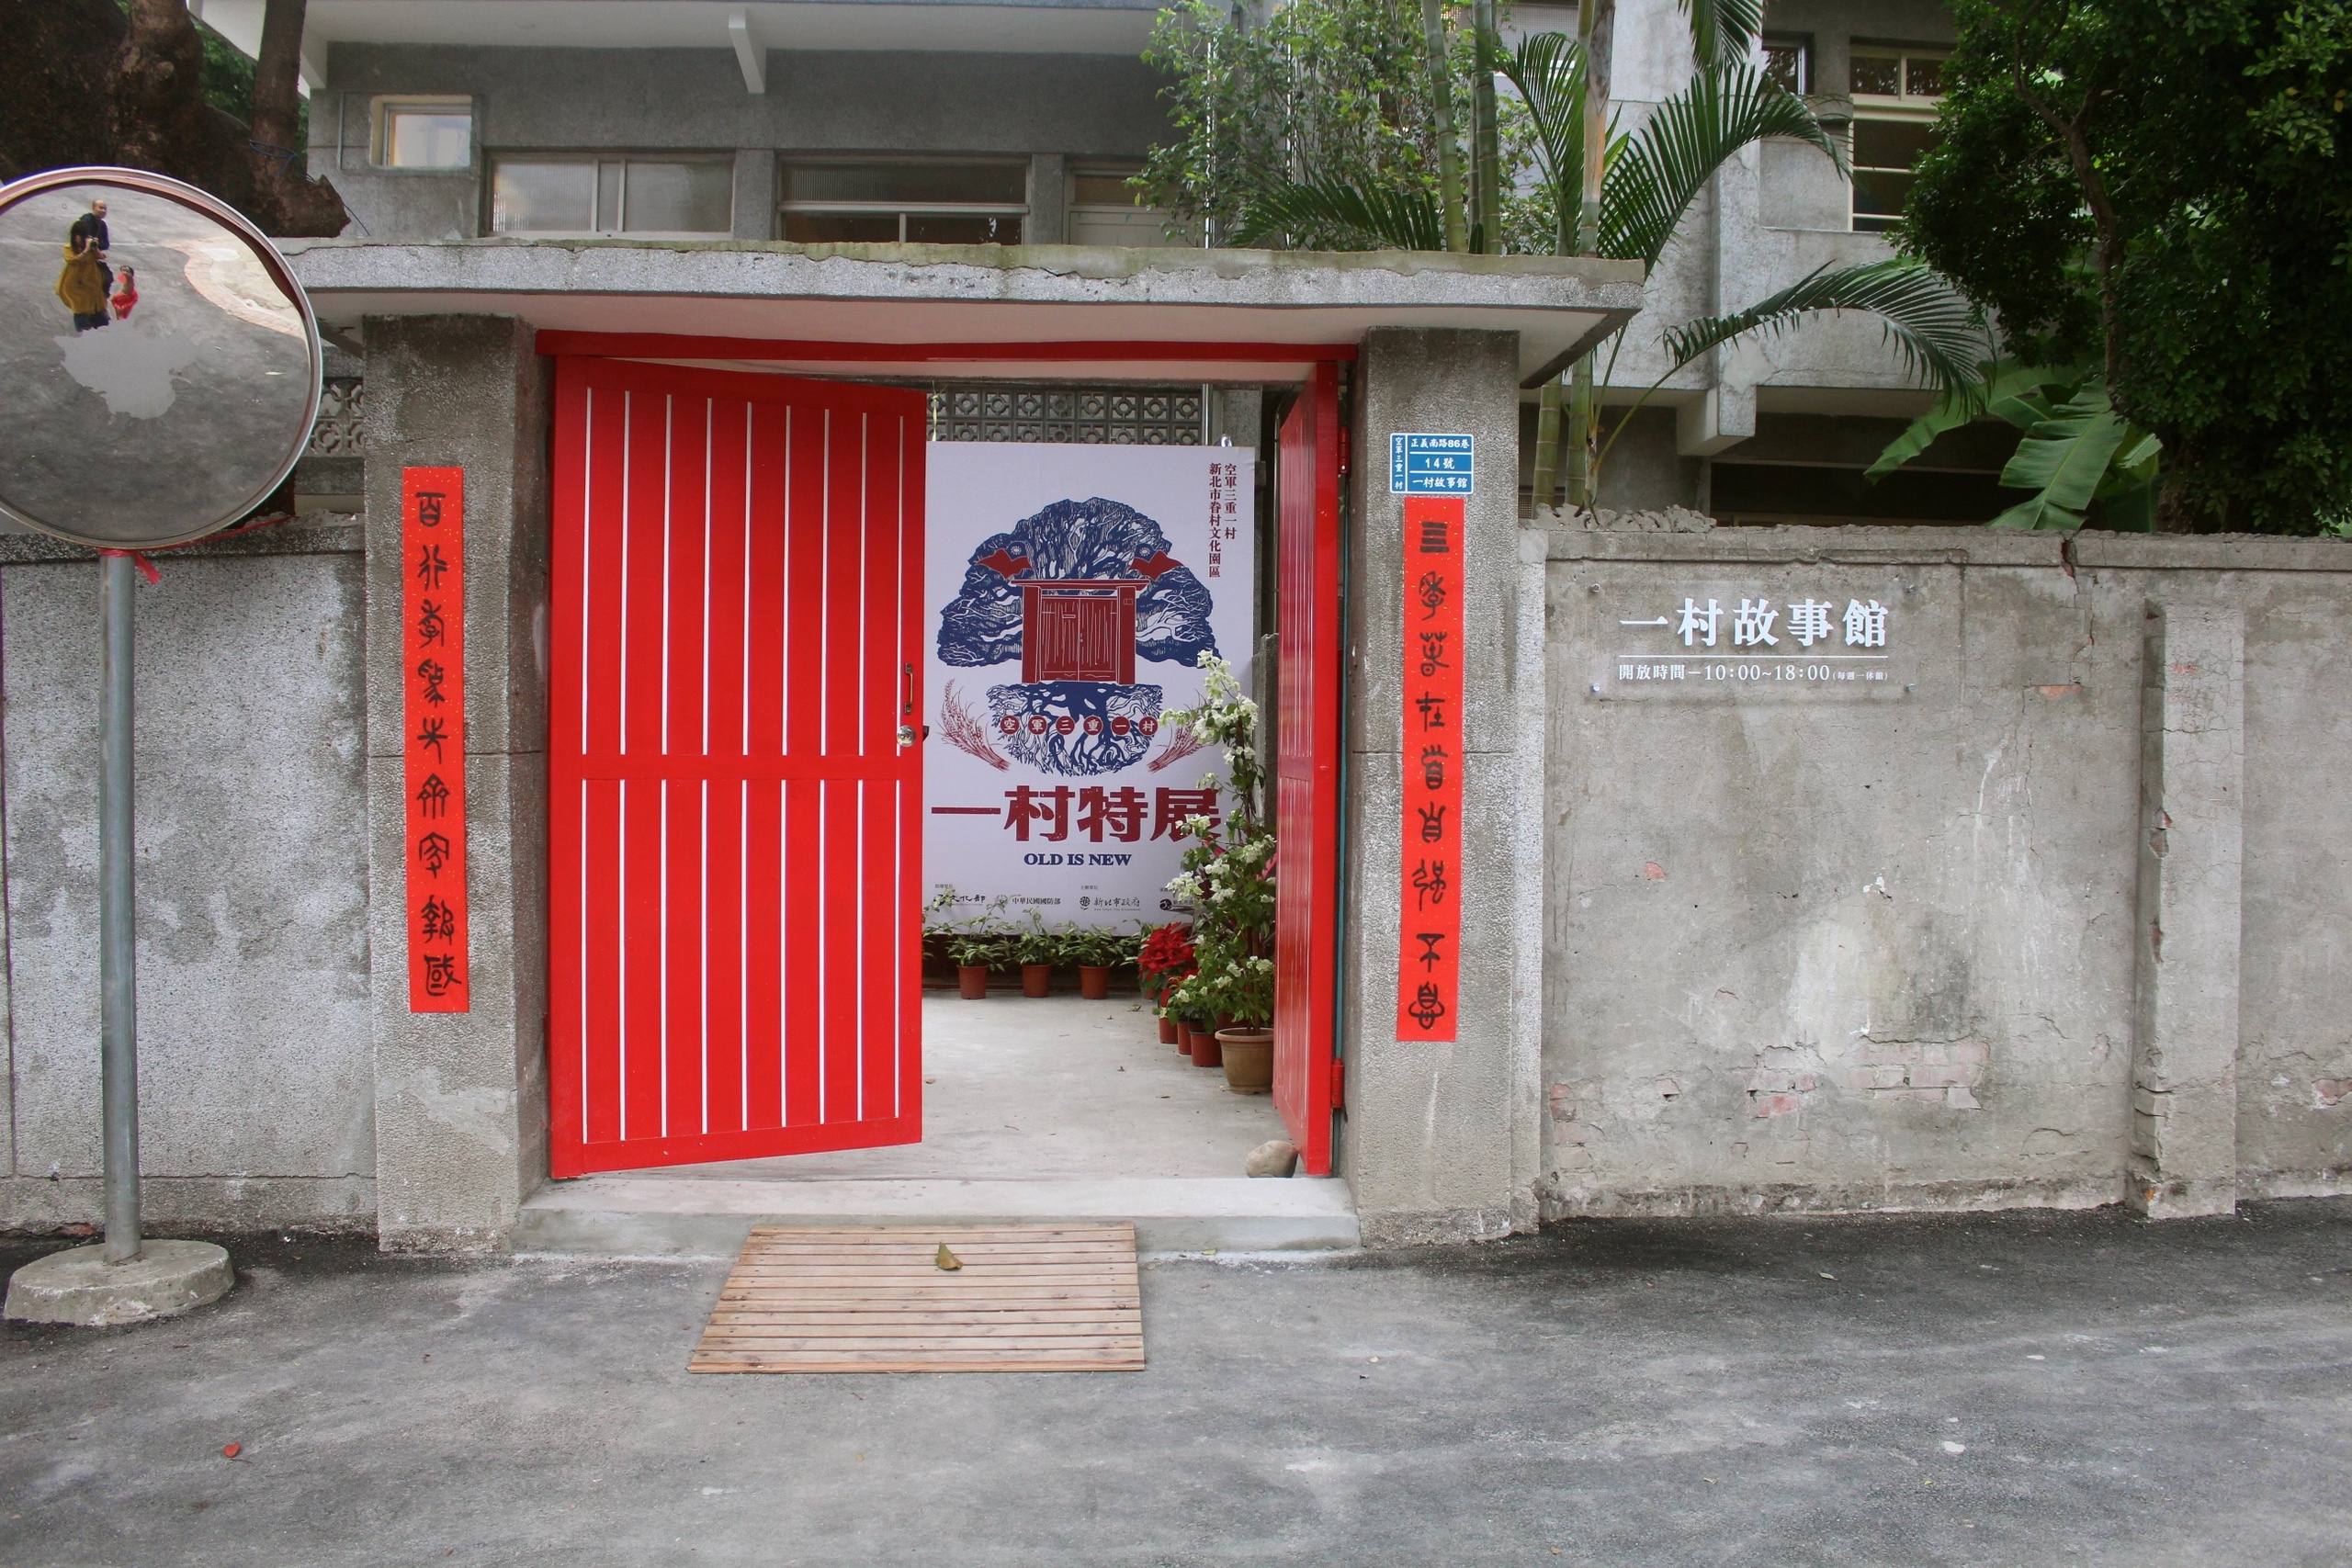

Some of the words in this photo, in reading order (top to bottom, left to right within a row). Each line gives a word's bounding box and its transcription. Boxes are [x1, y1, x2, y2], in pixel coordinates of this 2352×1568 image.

[1410, 438, 1470, 449] 正義南路86巷
[1395, 436, 1404, 490] 空軍三重一村
[1425, 457, 1455, 469] 14號
[1412, 477, 1468, 489] 一村故事館
[1224, 463, 1238, 540] 空軍三重一村
[1209, 462, 1222, 578] 新北市眷村文化園區
[1619, 597, 1889, 648] 一村故事館
[1002, 716, 1156, 734] 空軍三重一村
[931, 785, 1223, 843] 一村特展
[1023, 853, 1063, 866] OLD
[1067, 853, 1084, 866] IS
[1088, 853, 1132, 866] NEW
[1093, 897, 1140, 908] 新北市政府
